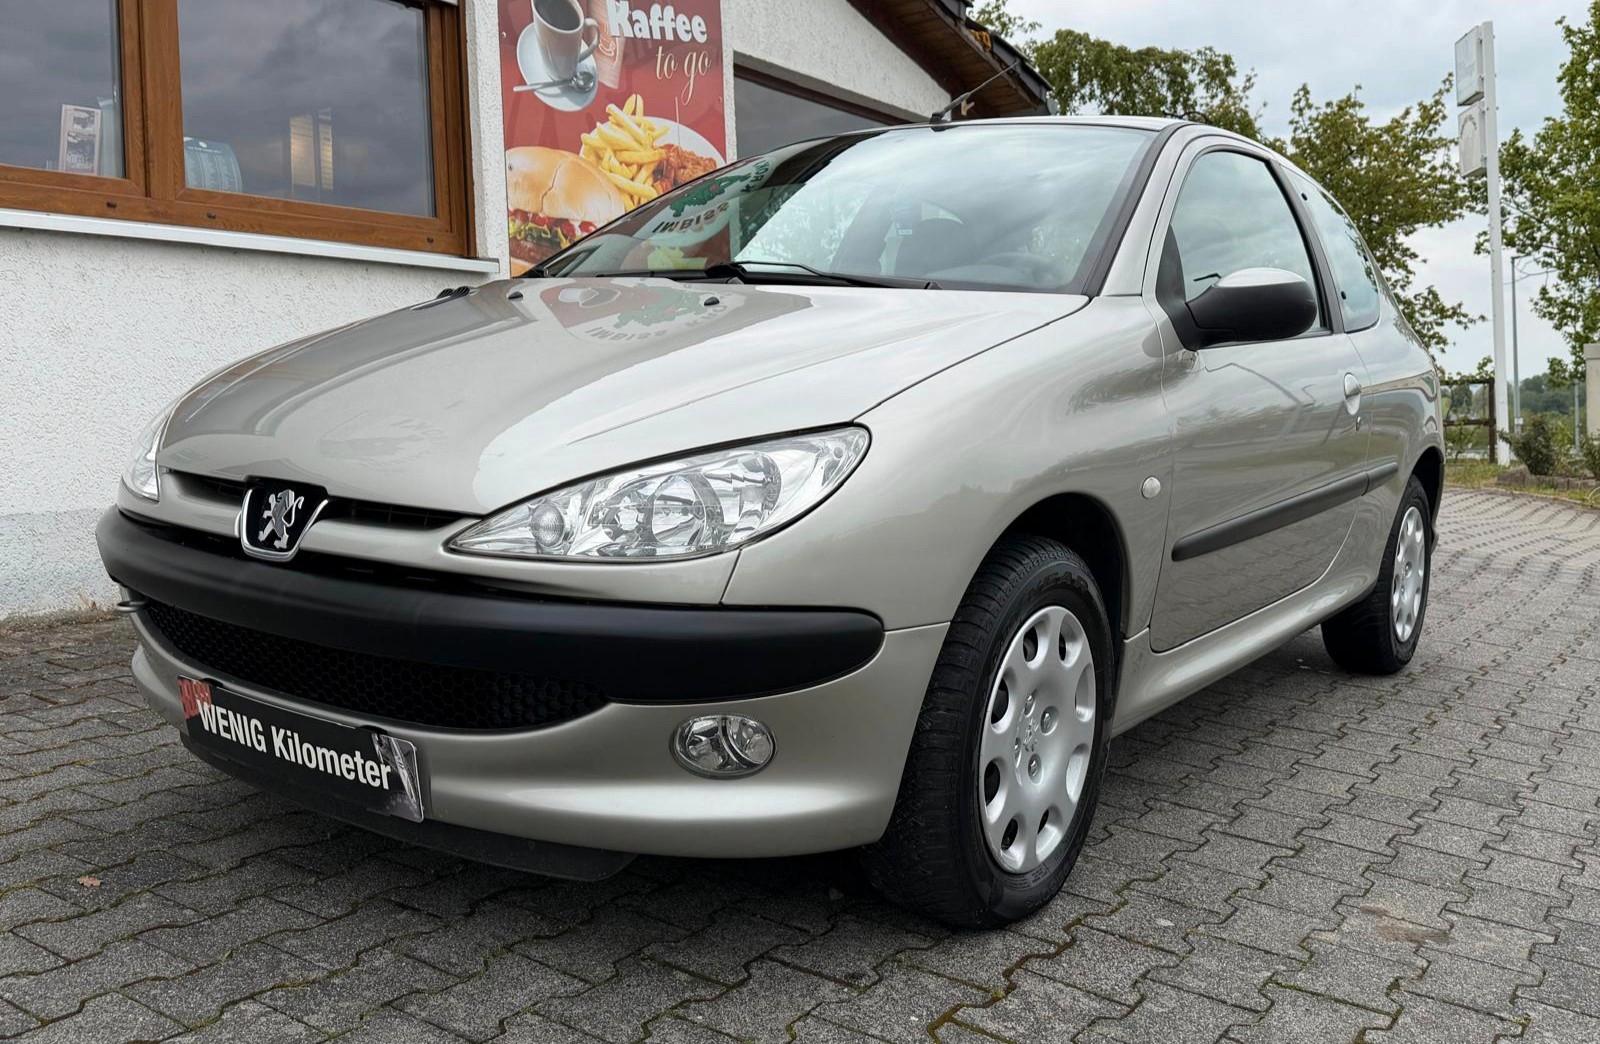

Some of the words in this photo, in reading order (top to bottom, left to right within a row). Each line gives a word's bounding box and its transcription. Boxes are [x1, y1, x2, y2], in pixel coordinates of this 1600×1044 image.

[606, 0, 708, 43] Kaffee
[656, 46, 679, 80] to
[681, 51, 712, 106] go
[196, 698, 267, 753] WENIG
[271, 725, 391, 791] Kilometer
